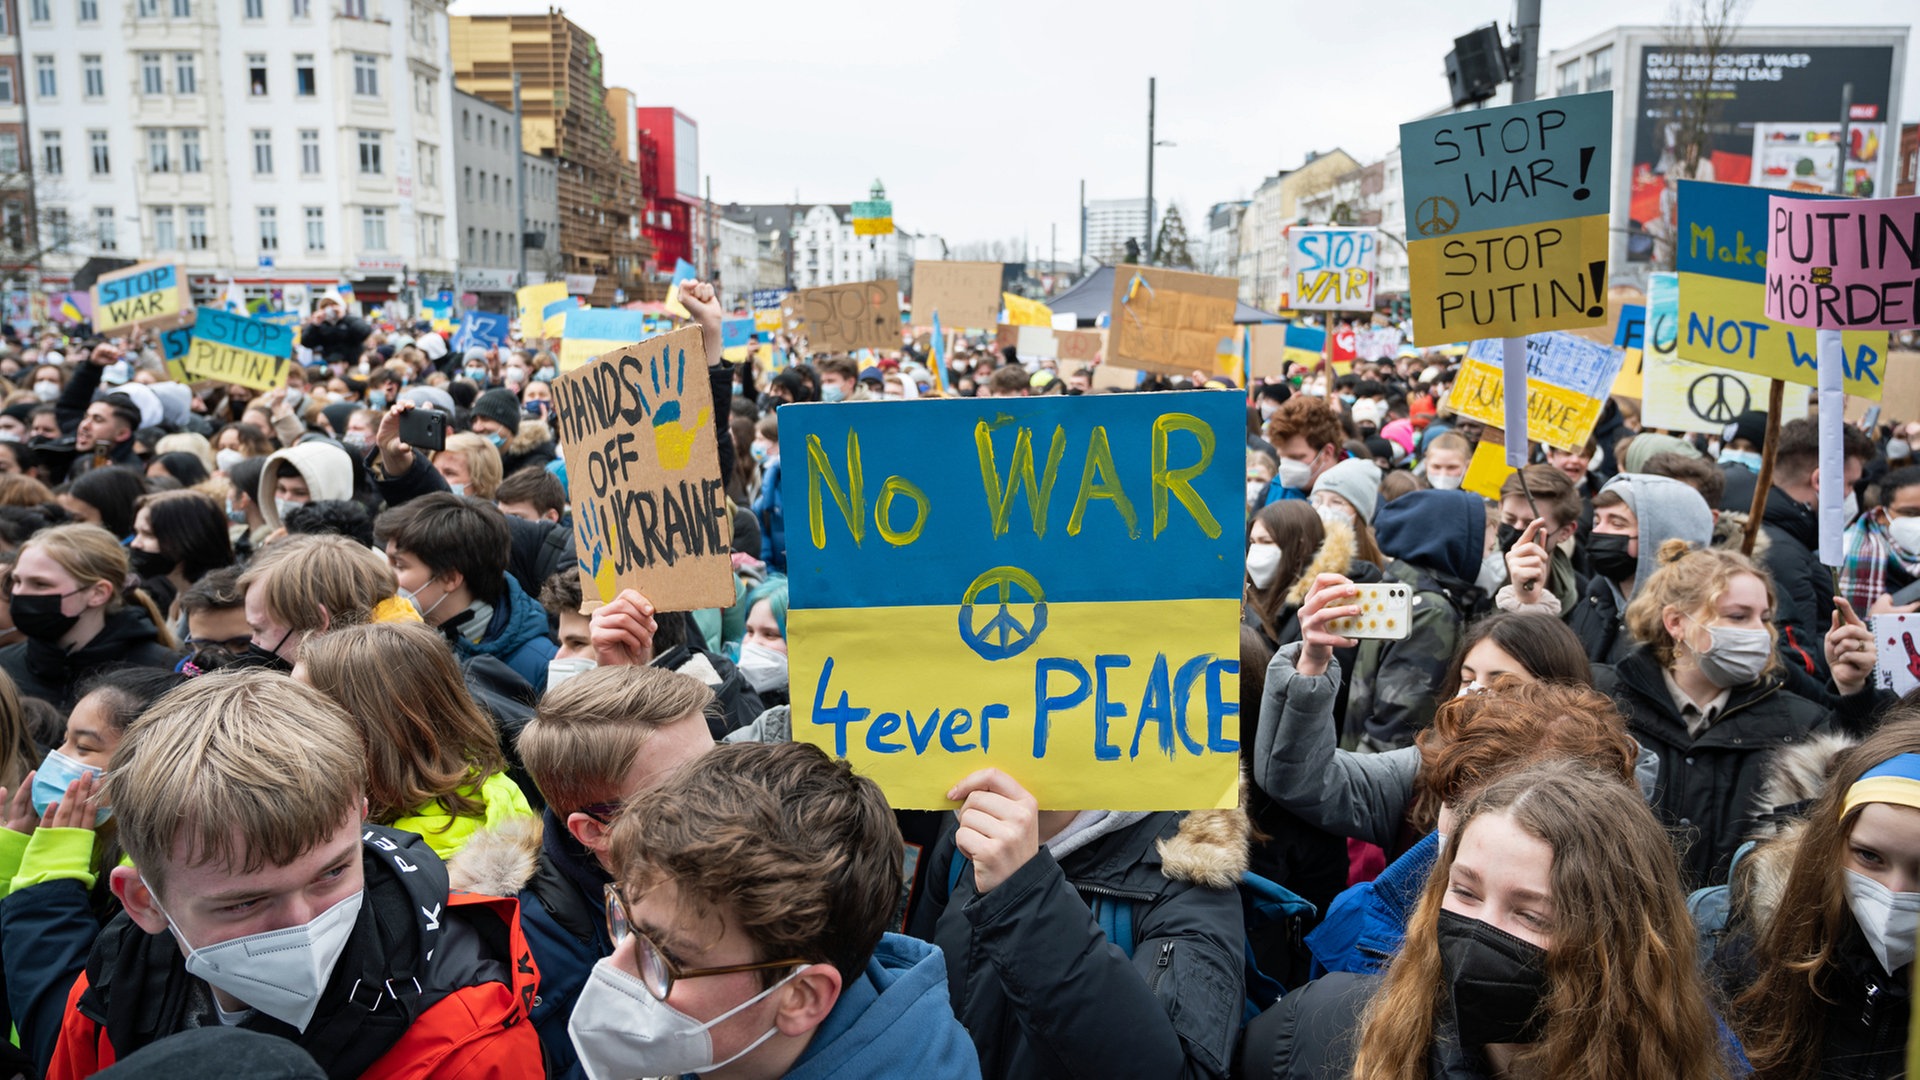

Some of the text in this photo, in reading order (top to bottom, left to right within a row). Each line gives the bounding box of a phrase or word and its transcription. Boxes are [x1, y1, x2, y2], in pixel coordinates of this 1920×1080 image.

[1748, 67, 1783, 81] DAS
[1763, 53, 1811, 68] WAS?
[1434, 109, 1567, 166] STOP
[1465, 145, 1597, 208] WAR!
[1297, 231, 1374, 272] STOP
[1443, 228, 1562, 276] STOP
[1775, 206, 1920, 270] PUTIN
[103, 266, 169, 303] STOP
[109, 292, 164, 323] WAR
[805, 283, 889, 323] STOP
[1296, 267, 1374, 308] WAR!
[1436, 260, 1607, 330] PUTIN!
[206, 314, 281, 349] STOP
[1687, 311, 1770, 360] NOT
[196, 341, 285, 387] PUTIN!
[554, 355, 644, 445] HANDS
[588, 432, 640, 499] OFF
[805, 411, 1223, 549] No WAR
[810, 650, 1240, 764] 4ever PEACE
